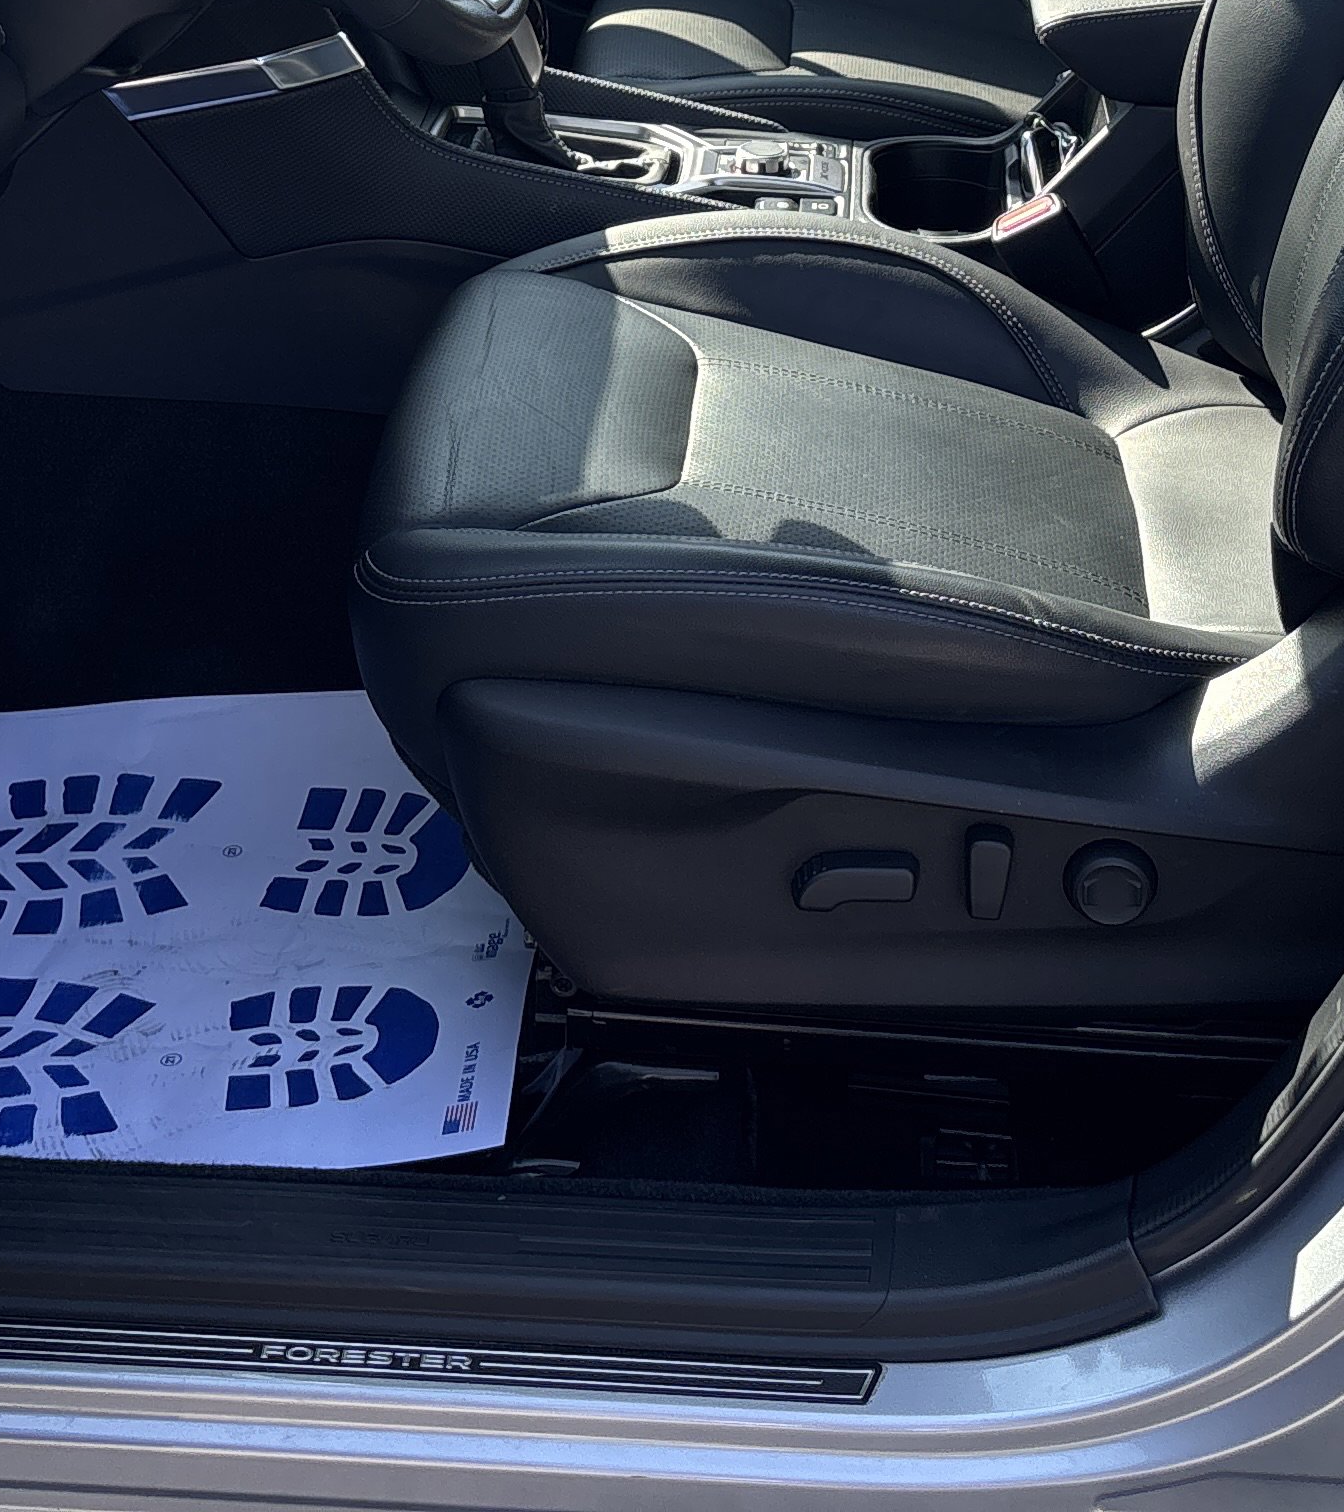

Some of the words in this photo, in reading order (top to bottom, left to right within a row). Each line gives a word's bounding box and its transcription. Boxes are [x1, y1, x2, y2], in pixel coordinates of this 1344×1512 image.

[465, 1041, 481, 1063] USA
[462, 1062, 478, 1075] IN
[457, 1074, 476, 1103] MADE
[259, 1344, 474, 1371] FORESTER
